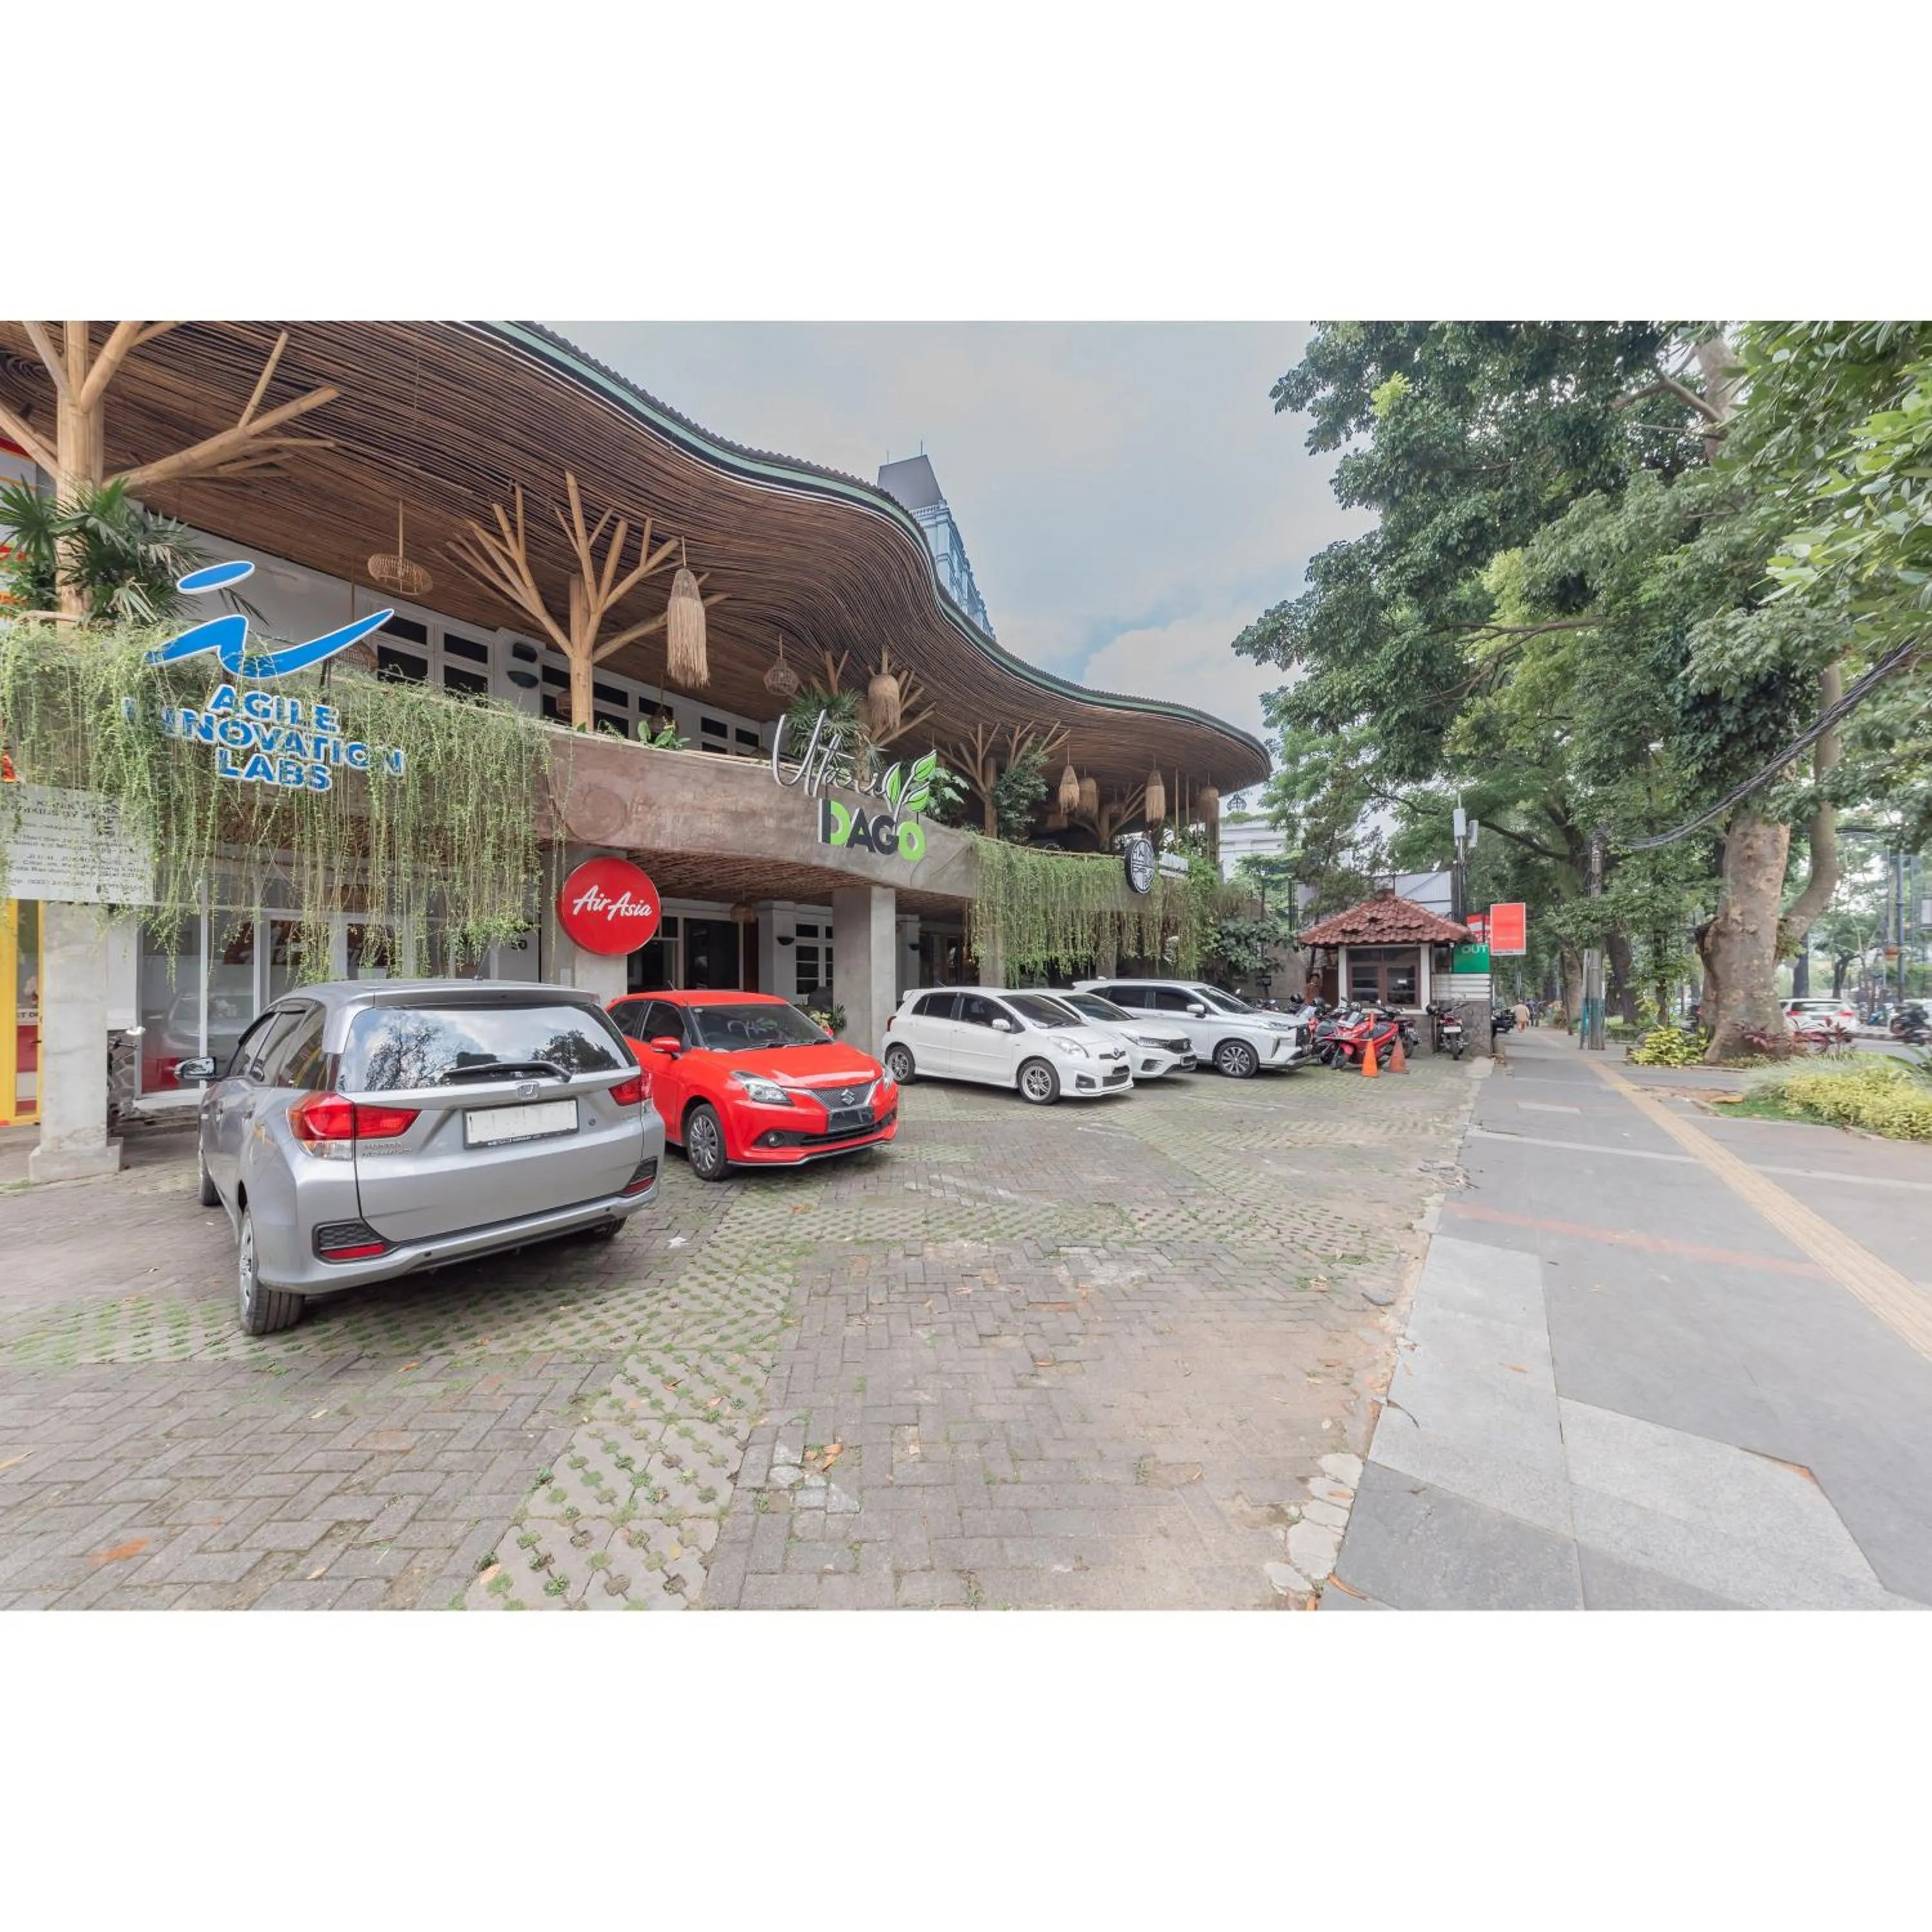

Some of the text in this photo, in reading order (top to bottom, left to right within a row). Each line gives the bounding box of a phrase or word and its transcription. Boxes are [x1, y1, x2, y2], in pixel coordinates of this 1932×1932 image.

[207, 684, 341, 734] AGILE
[214, 746, 333, 792] LABS
[817, 796, 926, 862] DAGO
[1461, 943, 1489, 954] OUT
